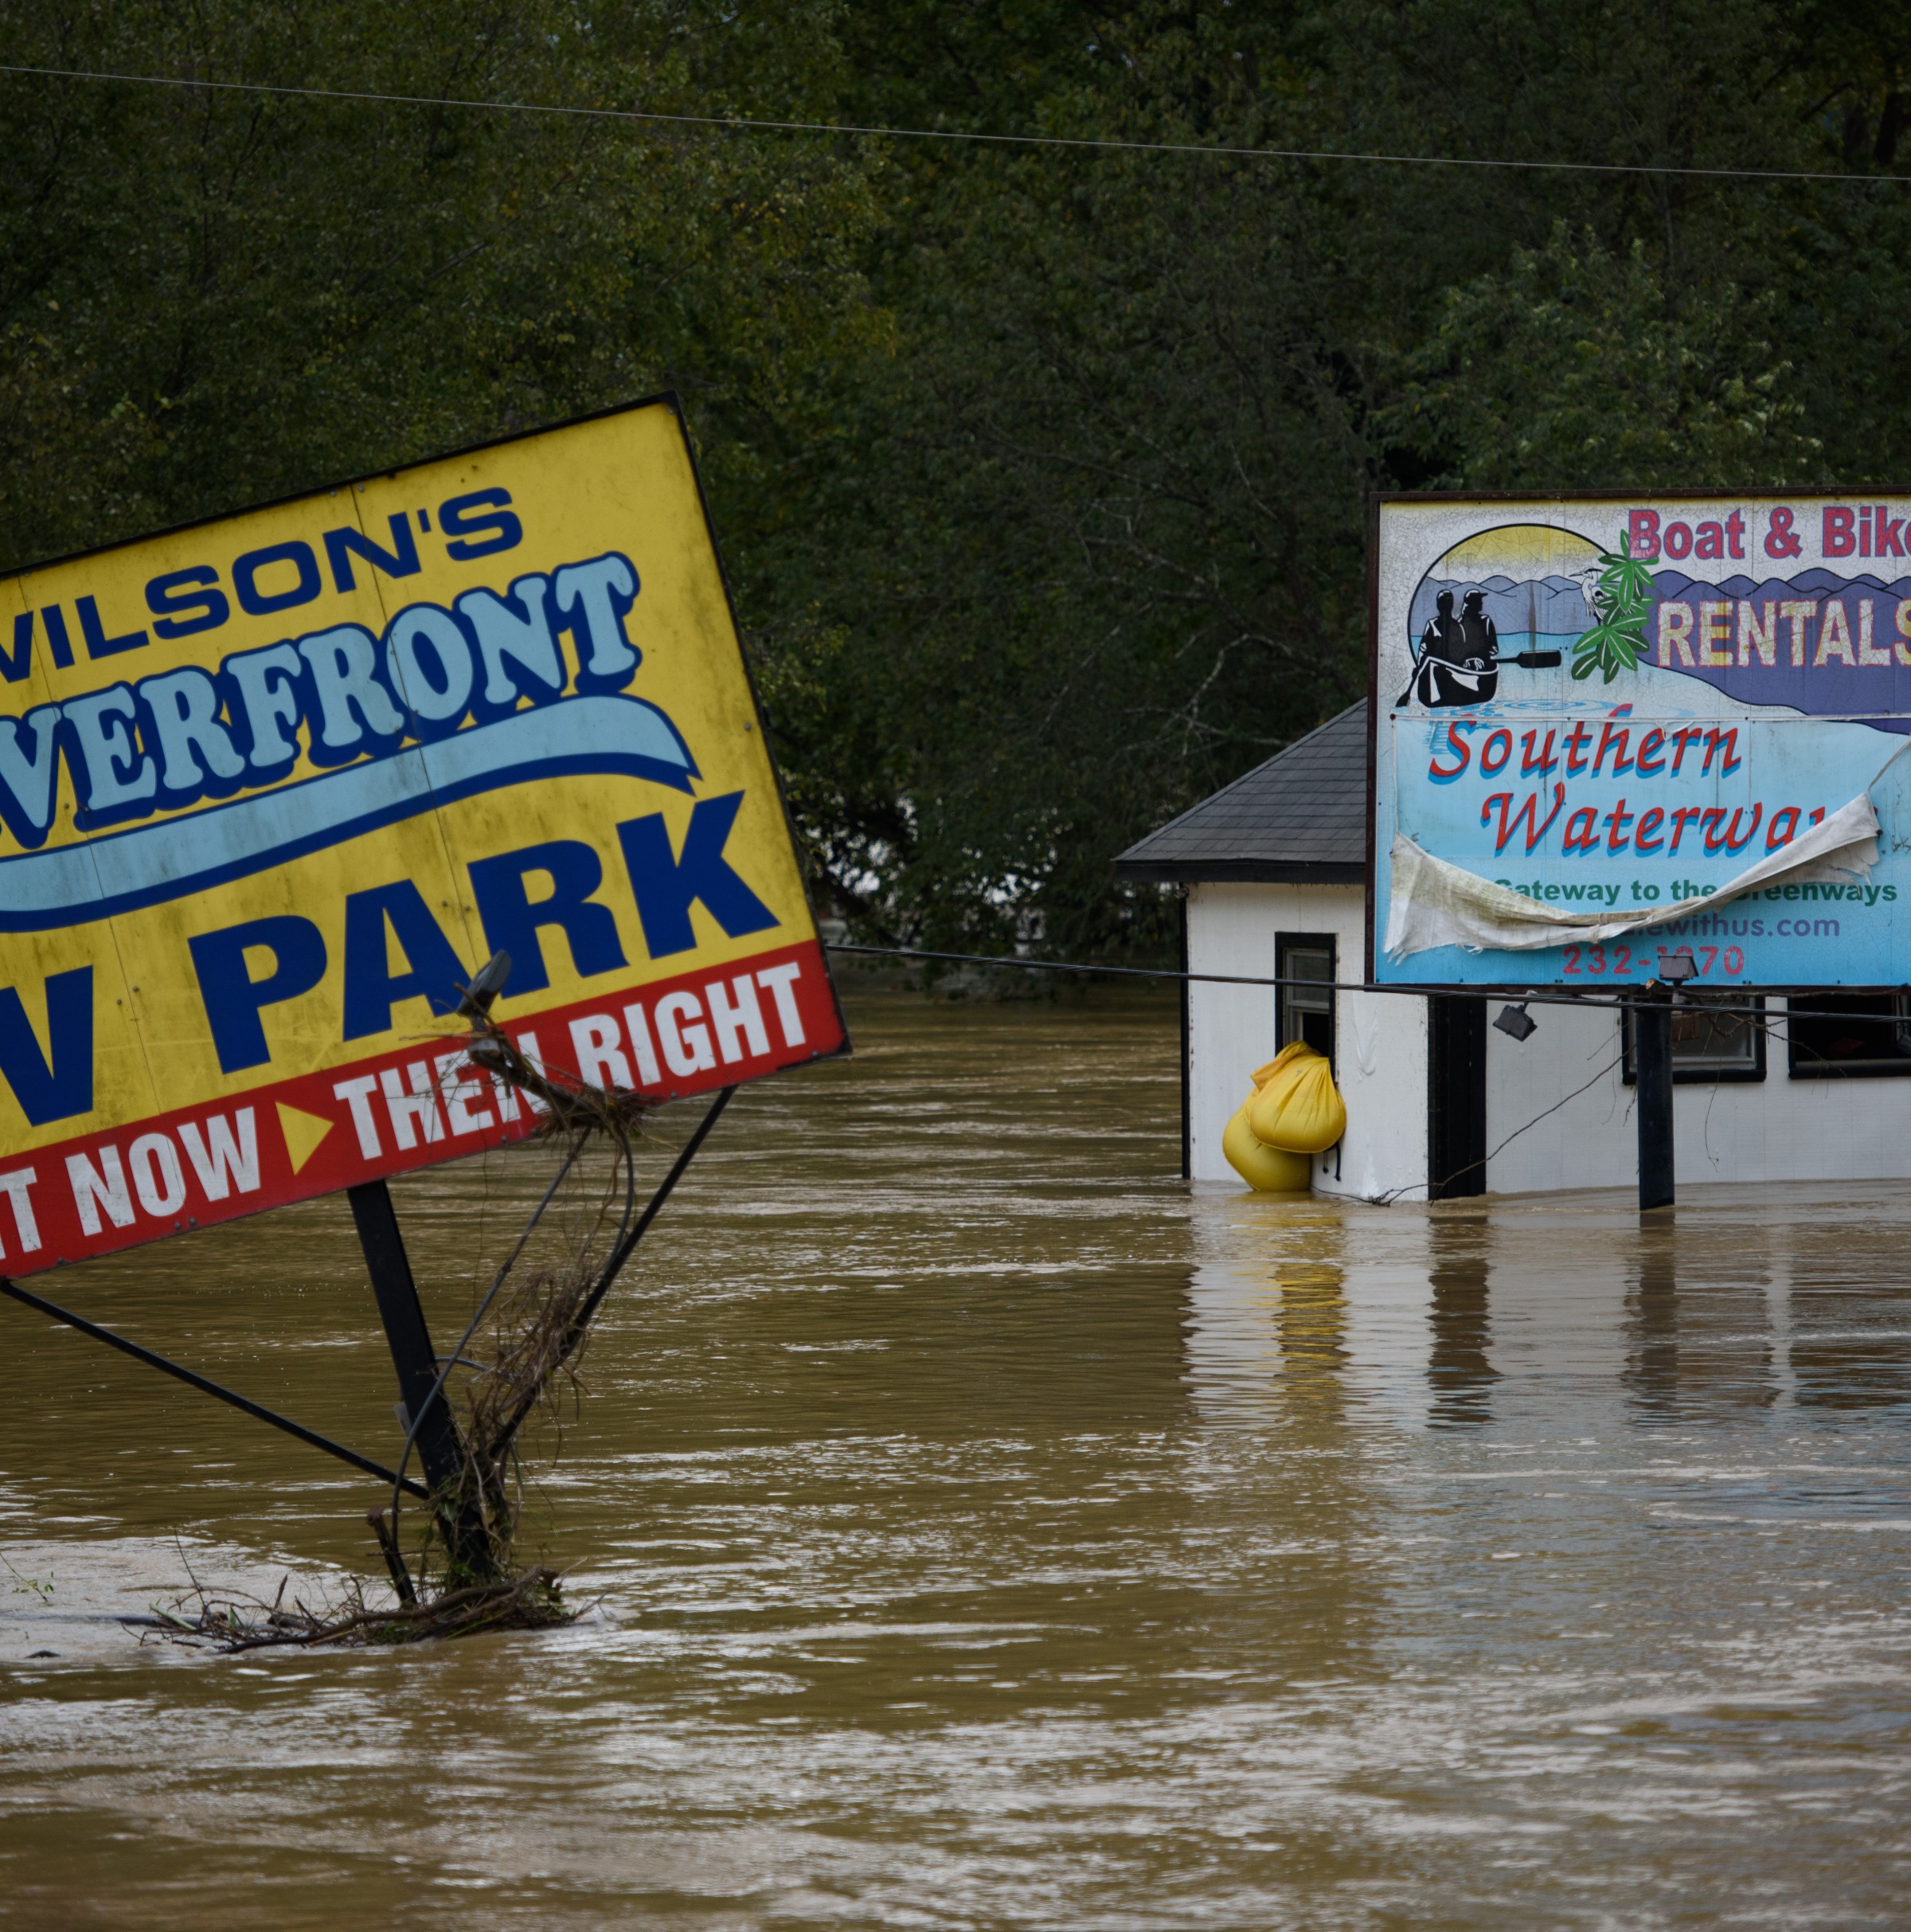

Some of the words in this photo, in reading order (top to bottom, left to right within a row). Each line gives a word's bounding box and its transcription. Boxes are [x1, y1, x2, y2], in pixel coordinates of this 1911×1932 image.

[1628, 508, 1746, 560] Boat
[1764, 506, 1803, 559] &
[1822, 506, 1911, 557] Bik
[1428, 703, 1742, 784] Southern
[1480, 782, 1878, 857] Waterwa
[1632, 879, 1660, 901] to
[1671, 879, 1718, 901] the
[187, 789, 782, 1075] PARK
[64, 1106, 261, 1236] NOW
[569, 961, 807, 1093] RIGHT
